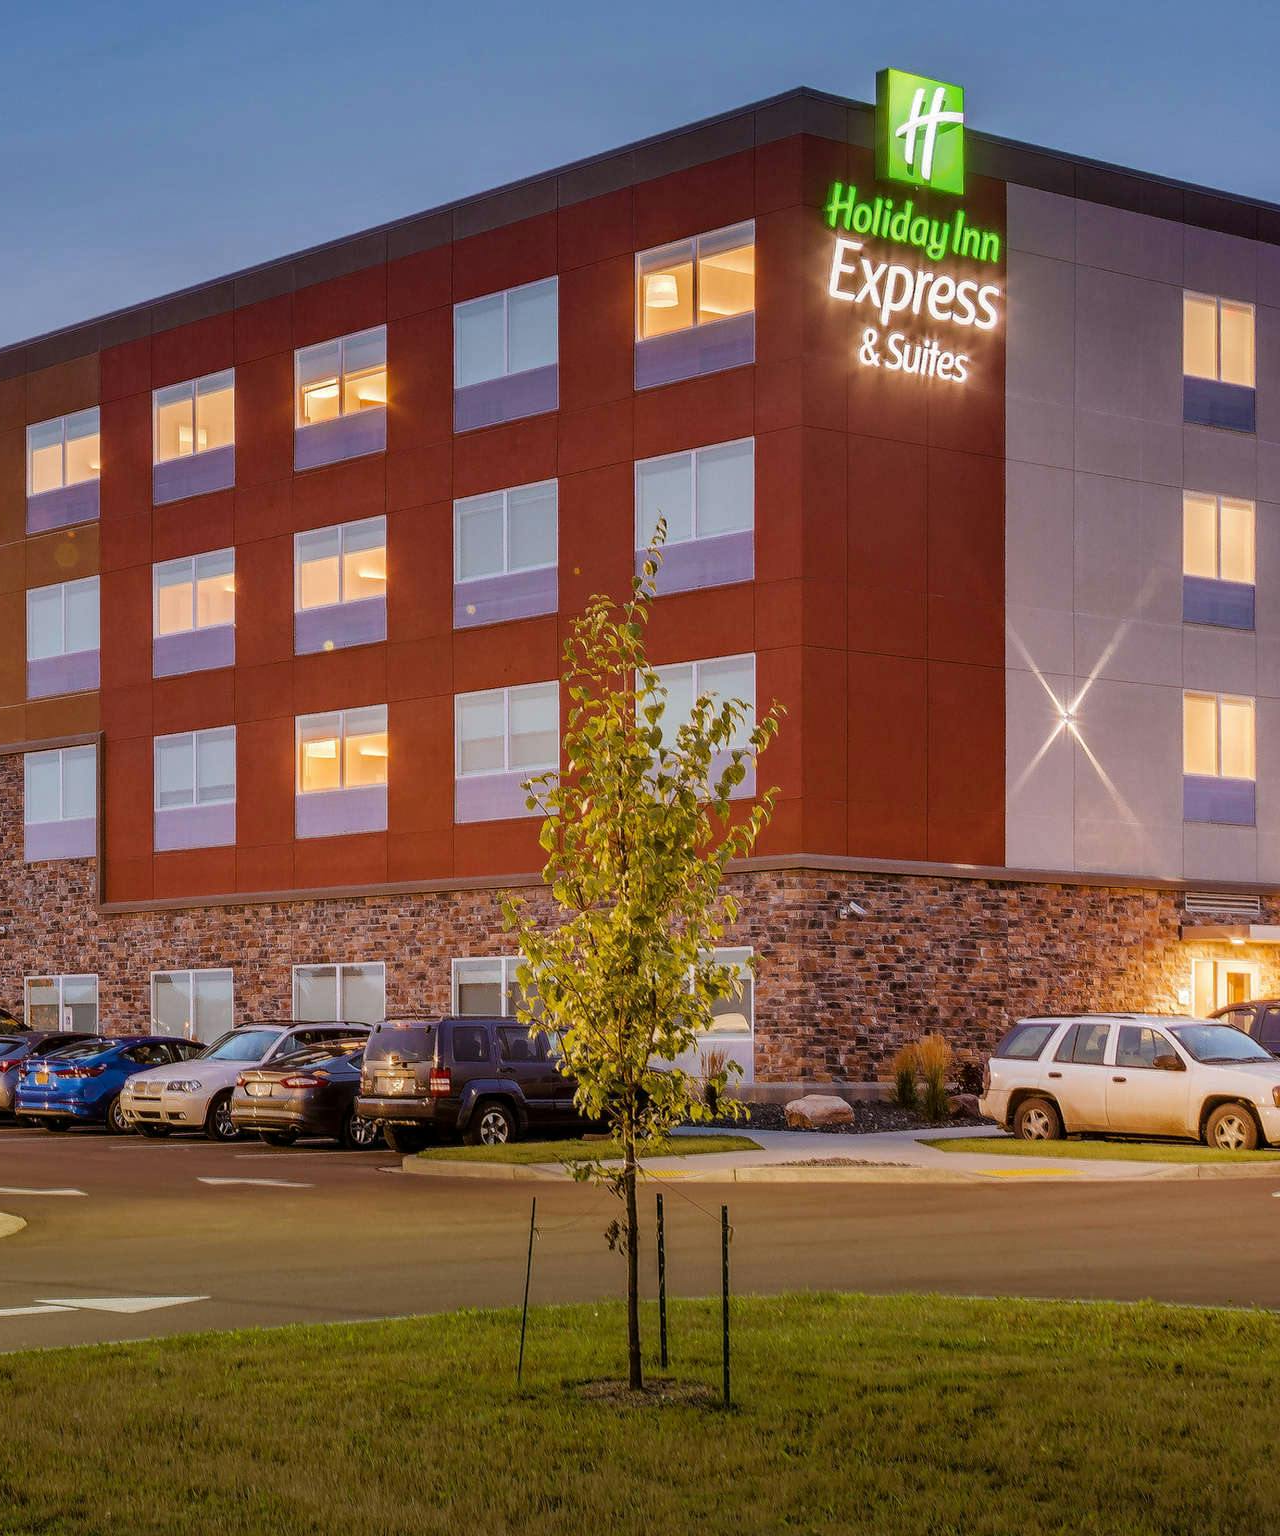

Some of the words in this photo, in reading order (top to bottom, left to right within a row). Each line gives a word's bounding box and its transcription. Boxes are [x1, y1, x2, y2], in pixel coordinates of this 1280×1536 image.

[827, 181, 949, 261] Holiday
[953, 209, 1000, 263] Inn
[829, 237, 1001, 330] Express
[858, 327, 880, 368] &
[886, 333, 969, 383] Suites
